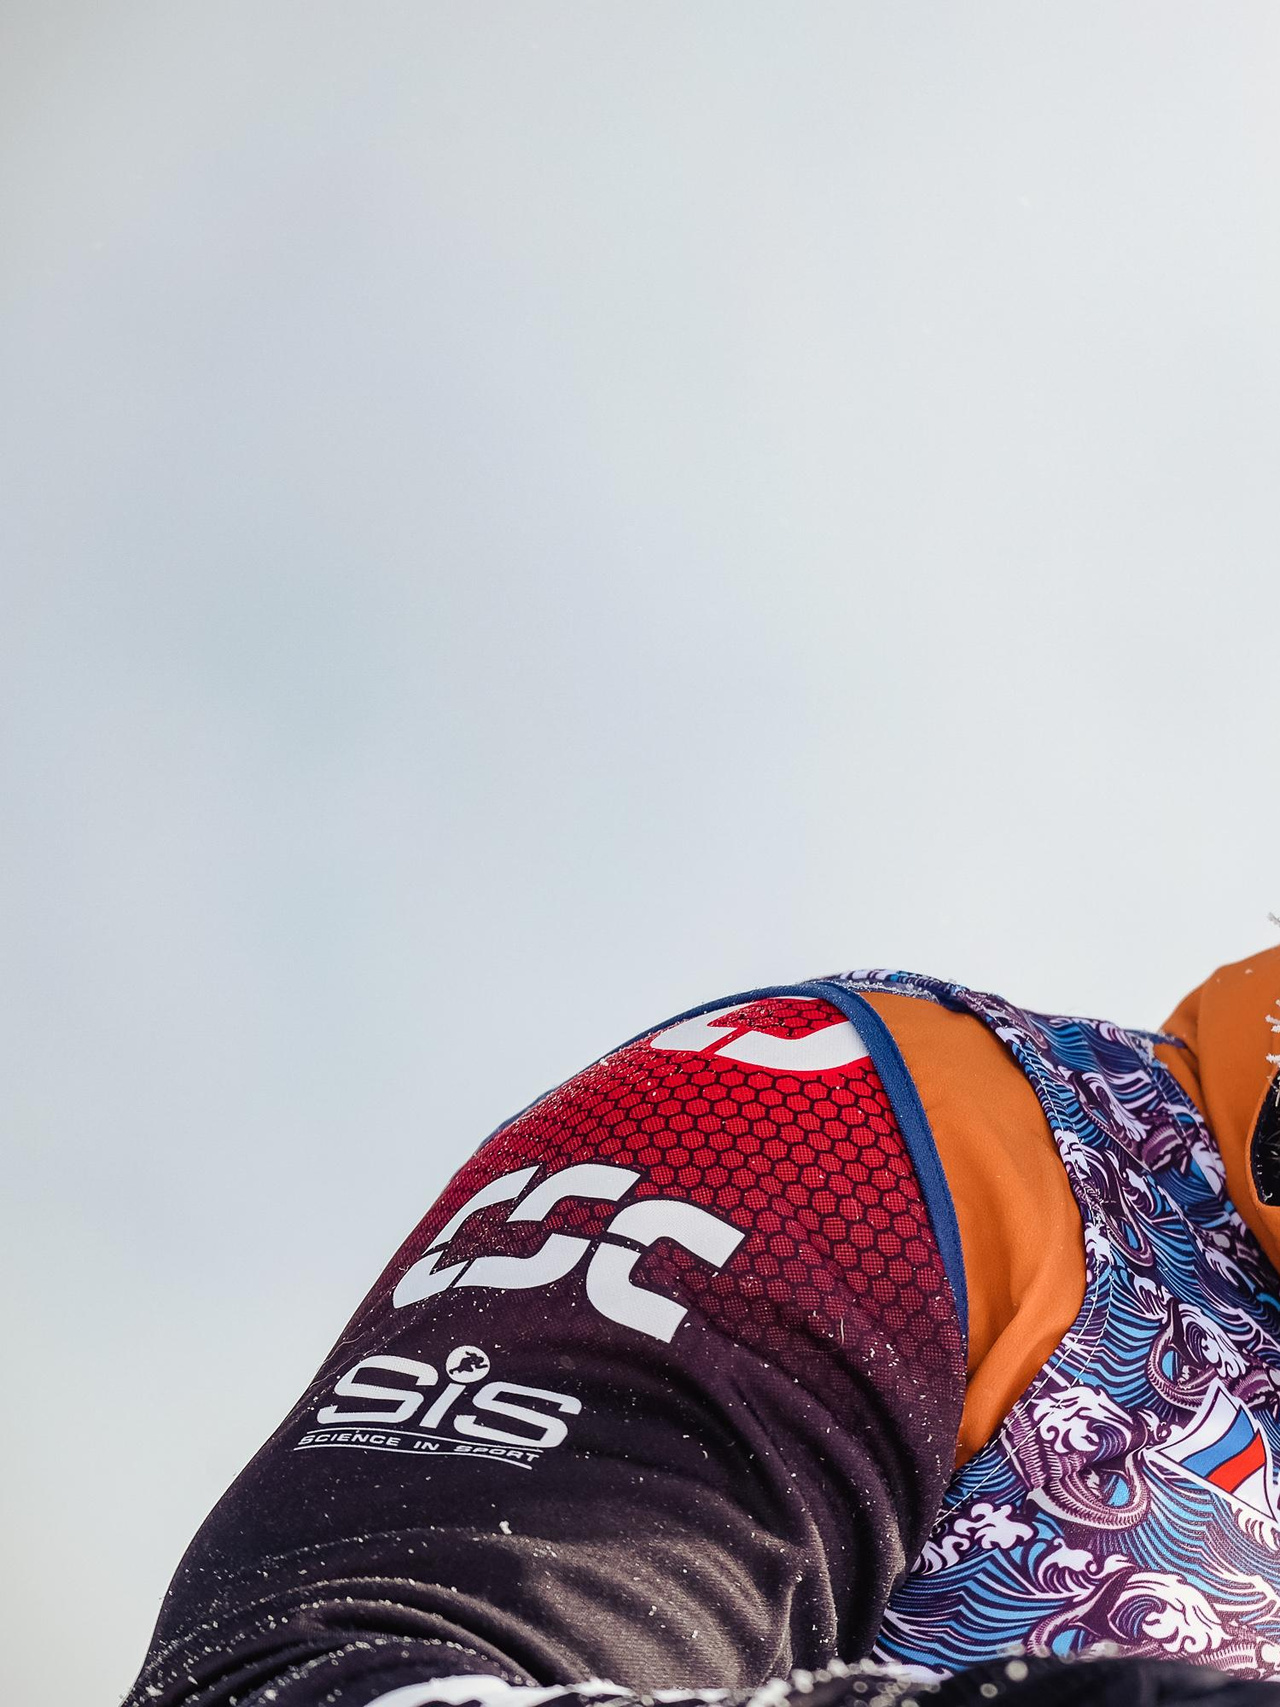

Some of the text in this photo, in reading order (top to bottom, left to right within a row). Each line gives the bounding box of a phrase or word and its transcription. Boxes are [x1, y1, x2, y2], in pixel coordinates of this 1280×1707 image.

[298, 1432, 541, 1463] SCIENCE IN SPORT
